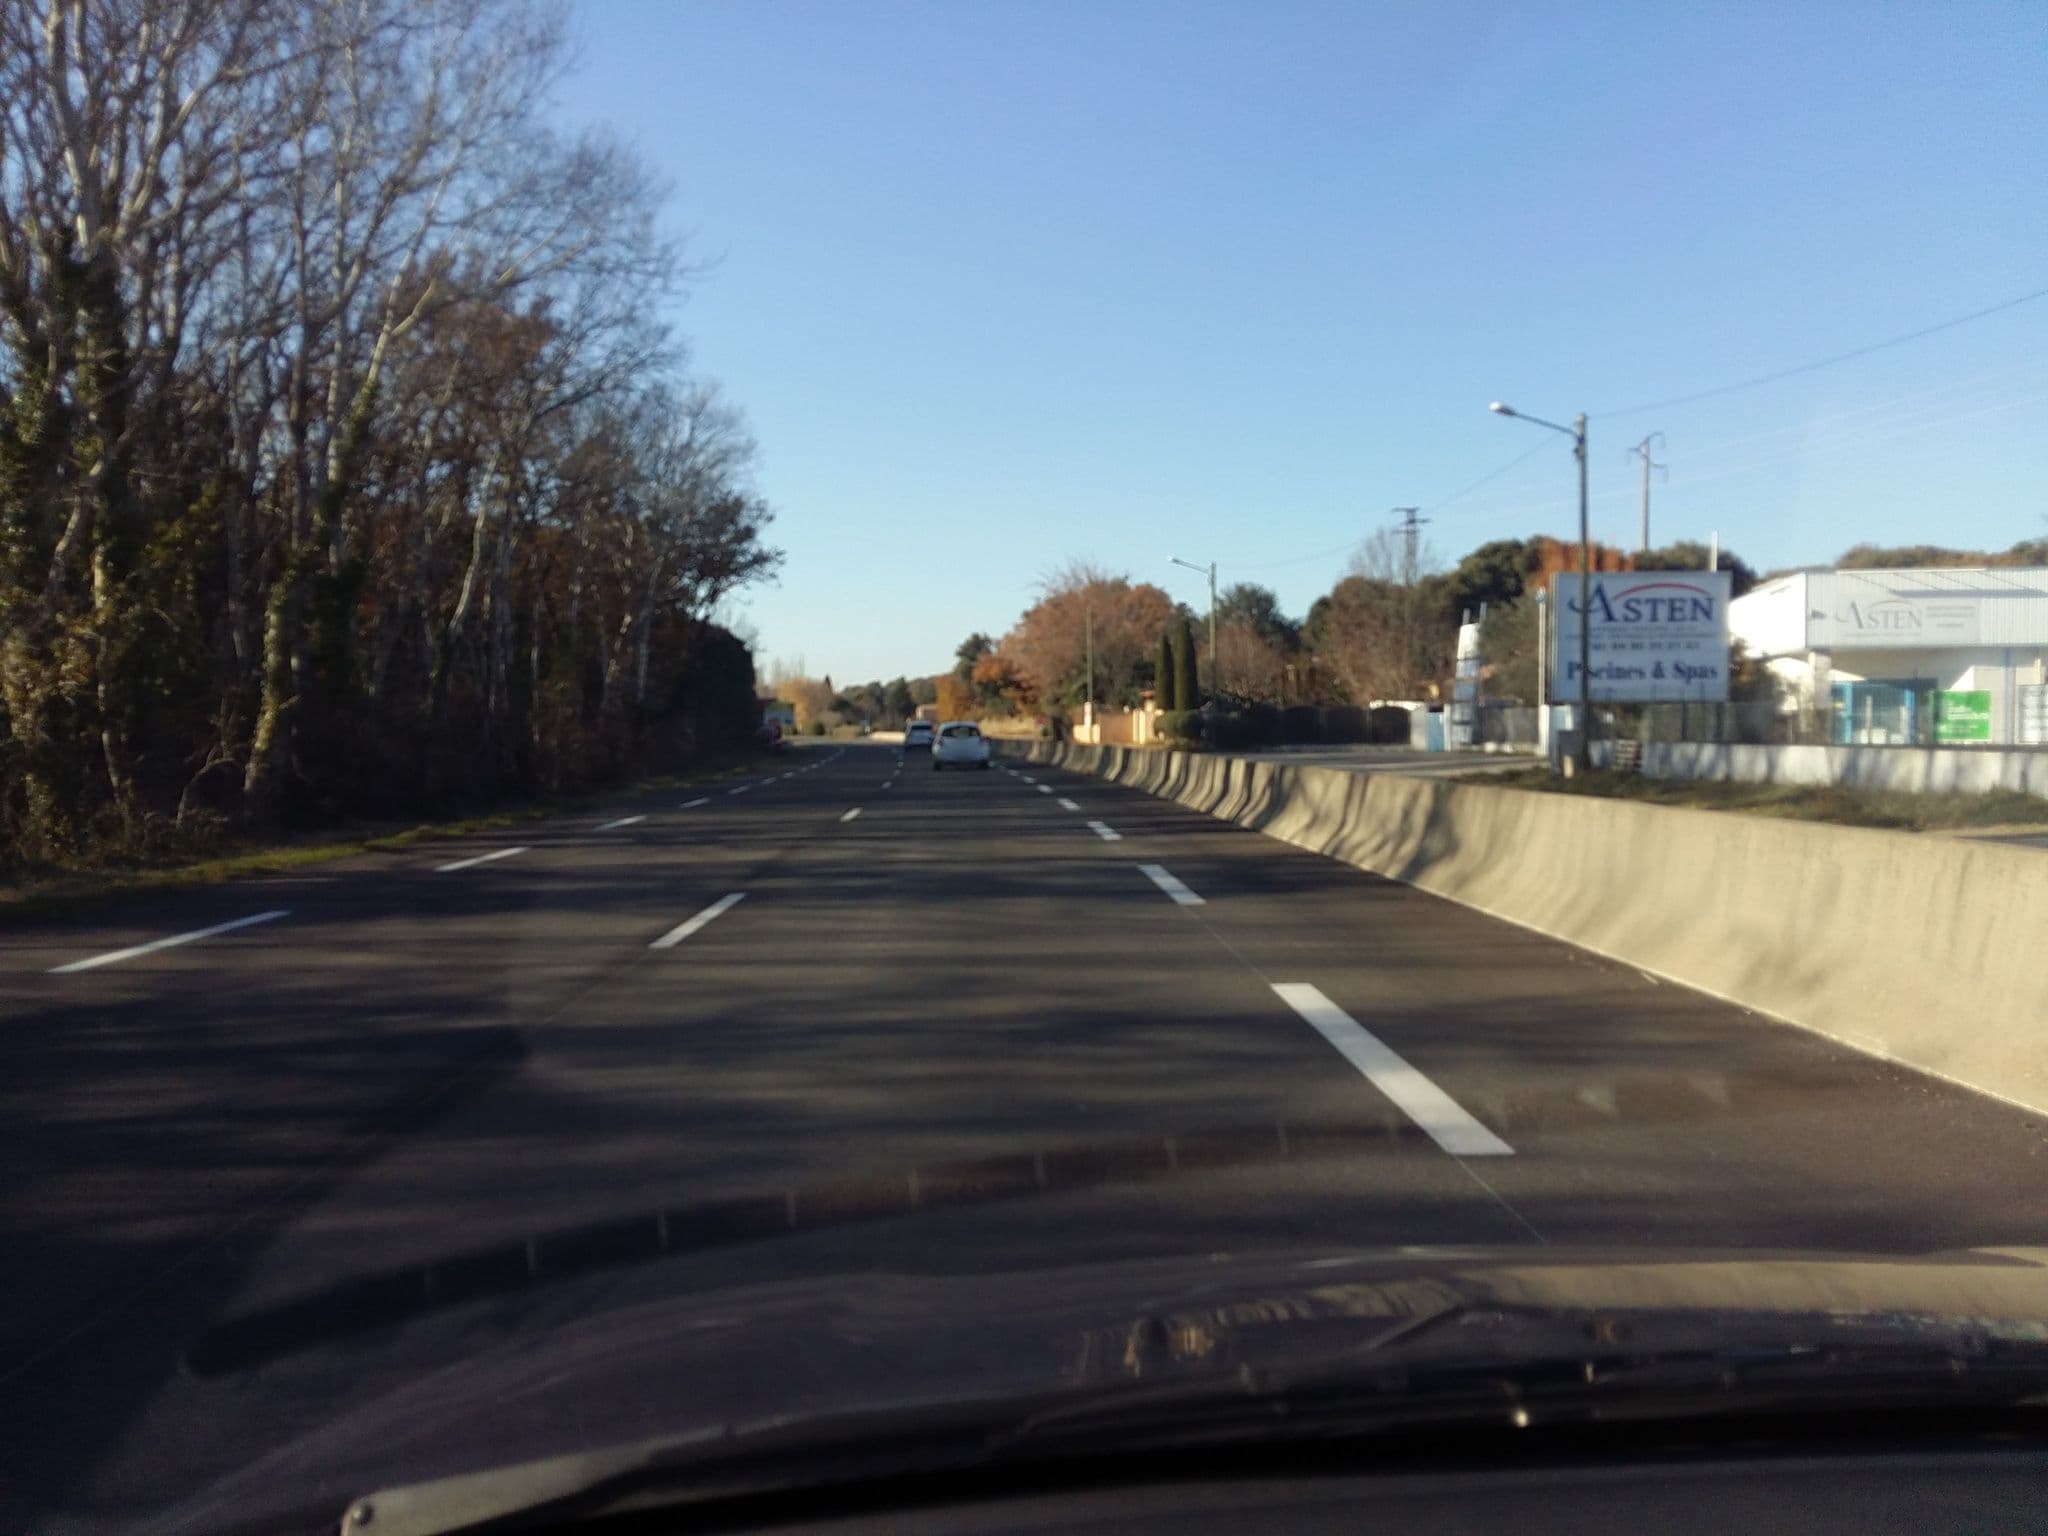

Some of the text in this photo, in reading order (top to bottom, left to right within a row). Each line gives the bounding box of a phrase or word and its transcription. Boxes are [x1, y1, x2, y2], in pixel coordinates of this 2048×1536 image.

[1567, 581, 1715, 622] ASTEN
[1834, 600, 1922, 629] ASTEN
[1567, 661, 1646, 680] Pscines
